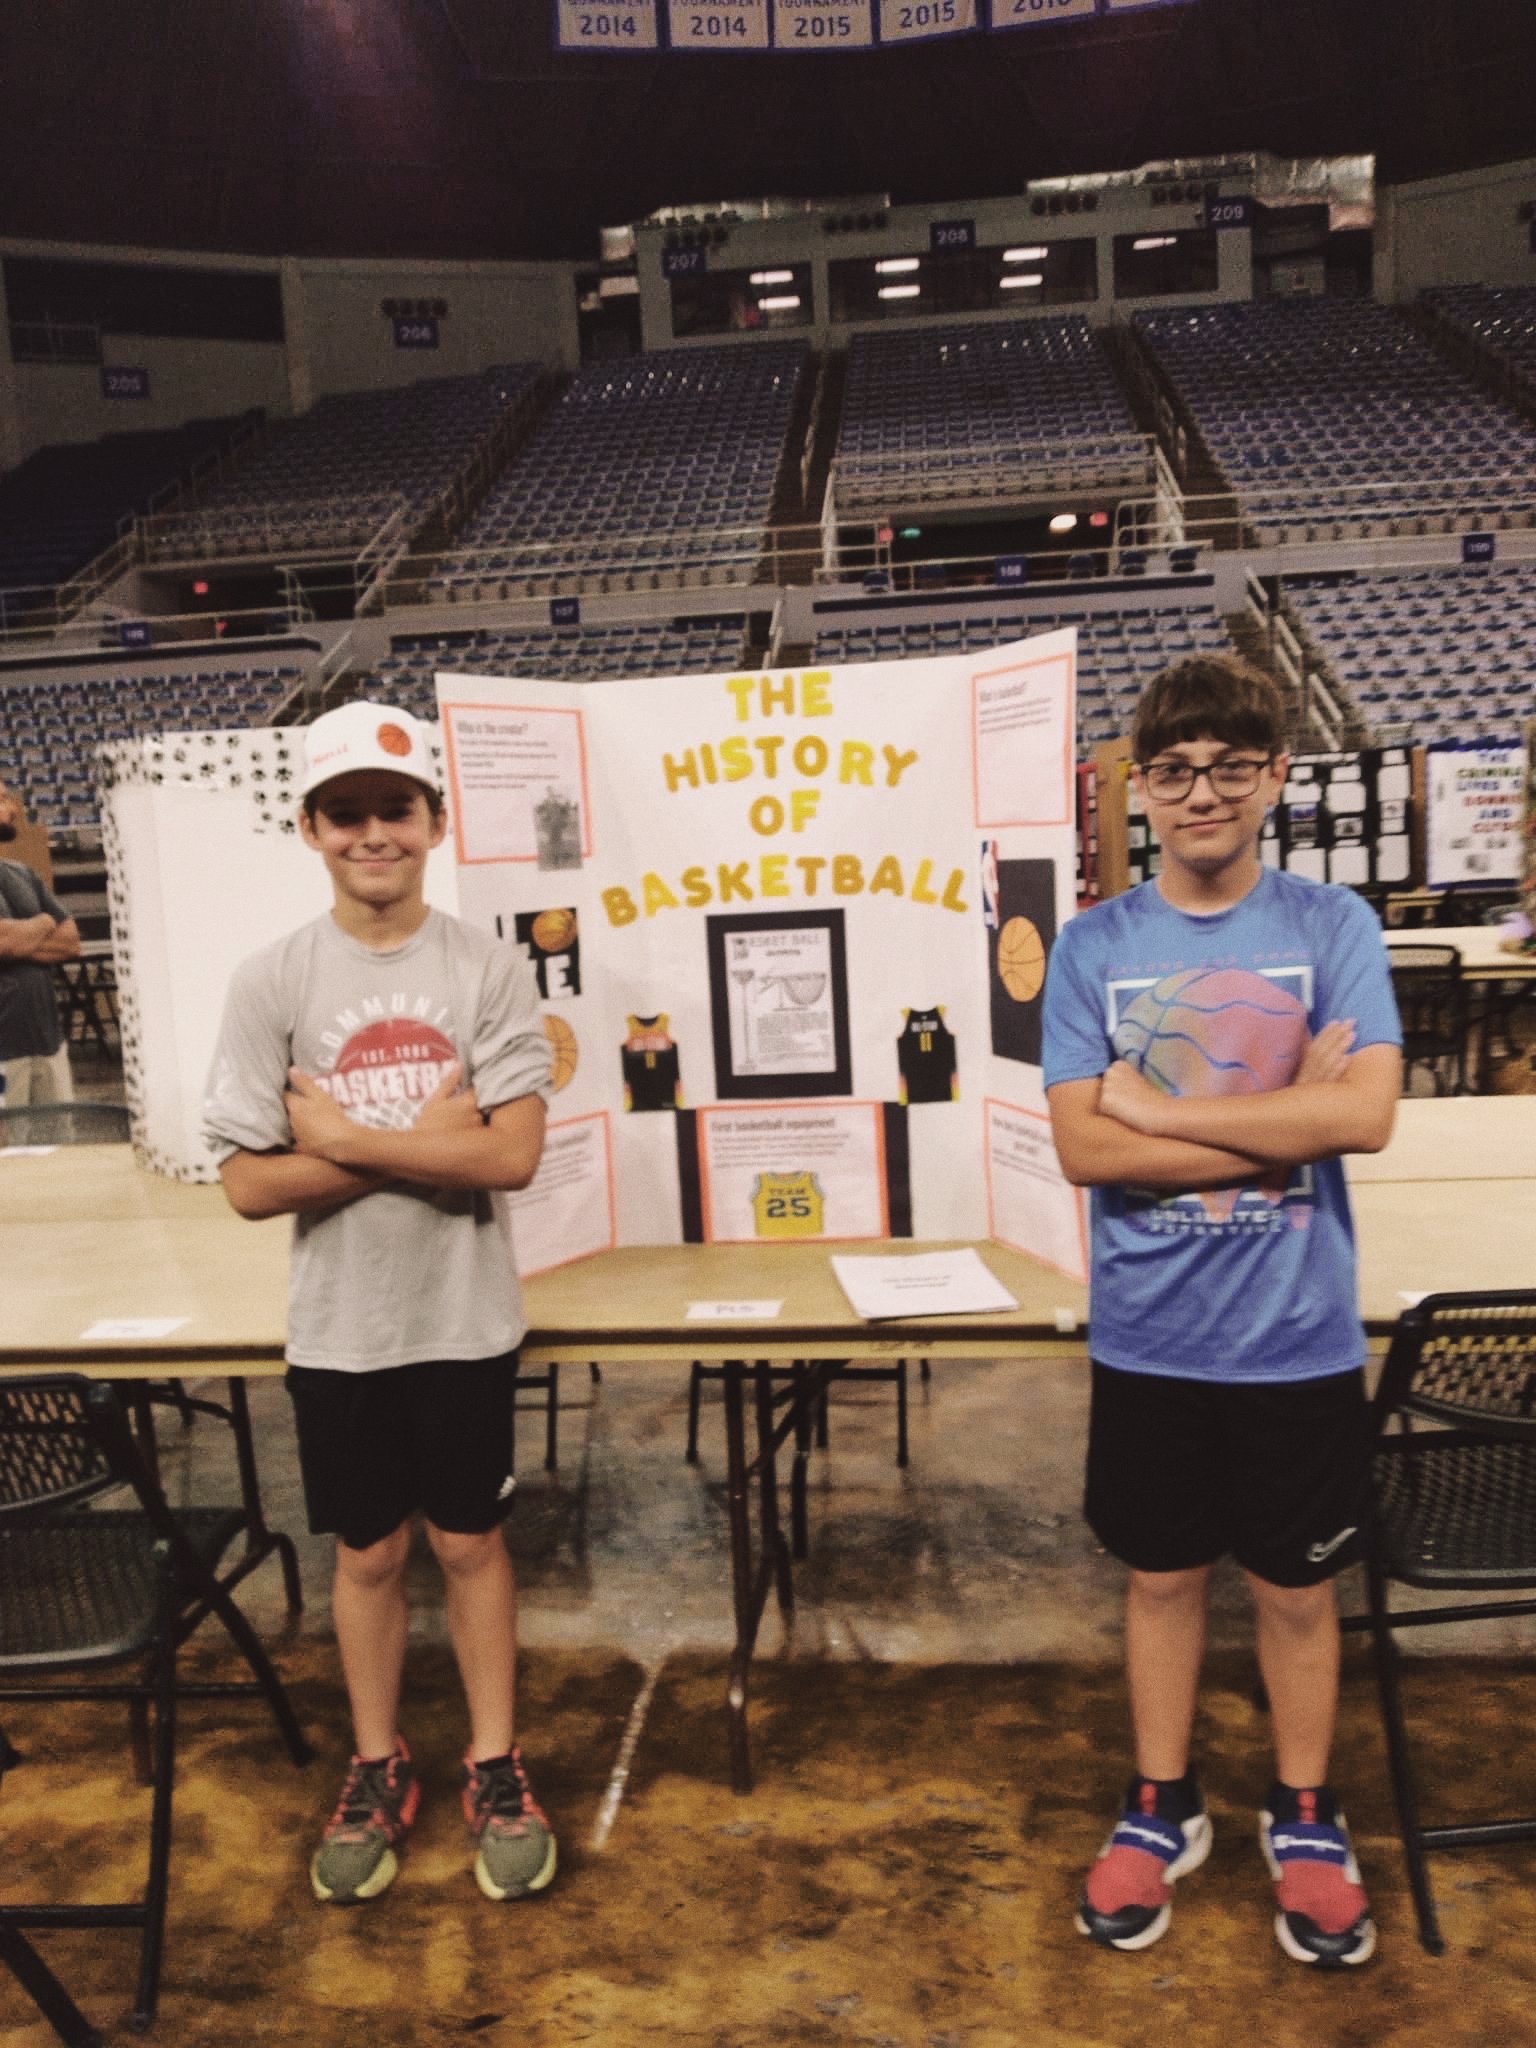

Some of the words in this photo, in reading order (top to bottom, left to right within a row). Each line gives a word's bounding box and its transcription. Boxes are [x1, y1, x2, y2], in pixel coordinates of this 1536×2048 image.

[580, 15, 637, 36] 2014
[690, 15, 747, 36] 2014
[794, 16, 851, 37] 2015
[900, 4, 954, 28] 2015
[1210, 204, 1244, 221] 209
[936, 229, 968, 244] 208
[668, 254, 699, 271] 207
[725, 671, 833, 721] THE
[662, 734, 918, 793] HISTORY
[748, 790, 820, 836] OF
[601, 854, 968, 928] BASKETBALL
[767, 1197, 811, 1218] 25
